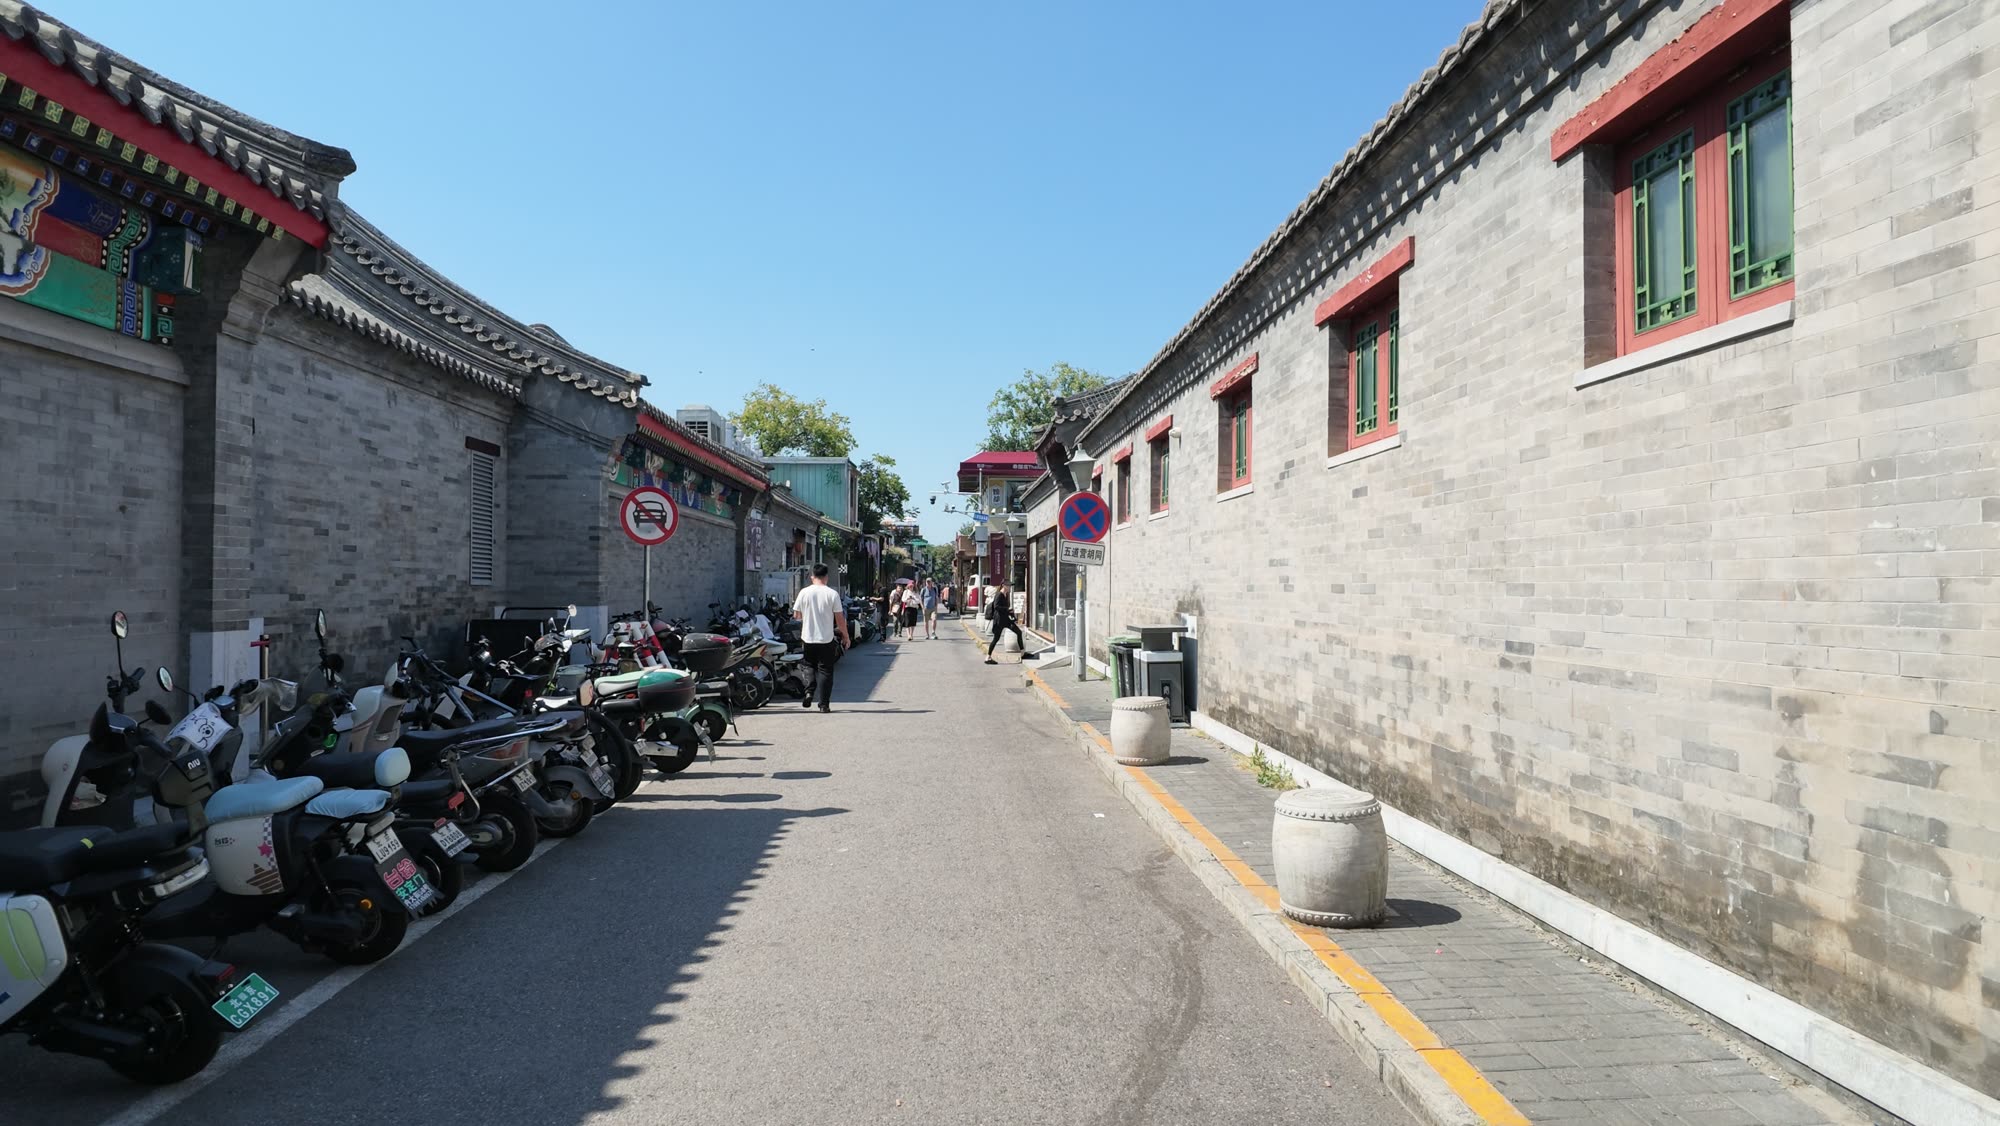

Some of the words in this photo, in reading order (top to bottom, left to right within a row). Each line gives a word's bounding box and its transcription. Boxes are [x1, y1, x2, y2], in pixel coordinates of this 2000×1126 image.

[1064, 546, 1103, 561] 五道营胡同
[383, 858, 417, 889] 台铃
[395, 873, 425, 900] 安定门
[229, 986, 276, 1025] CGX891
